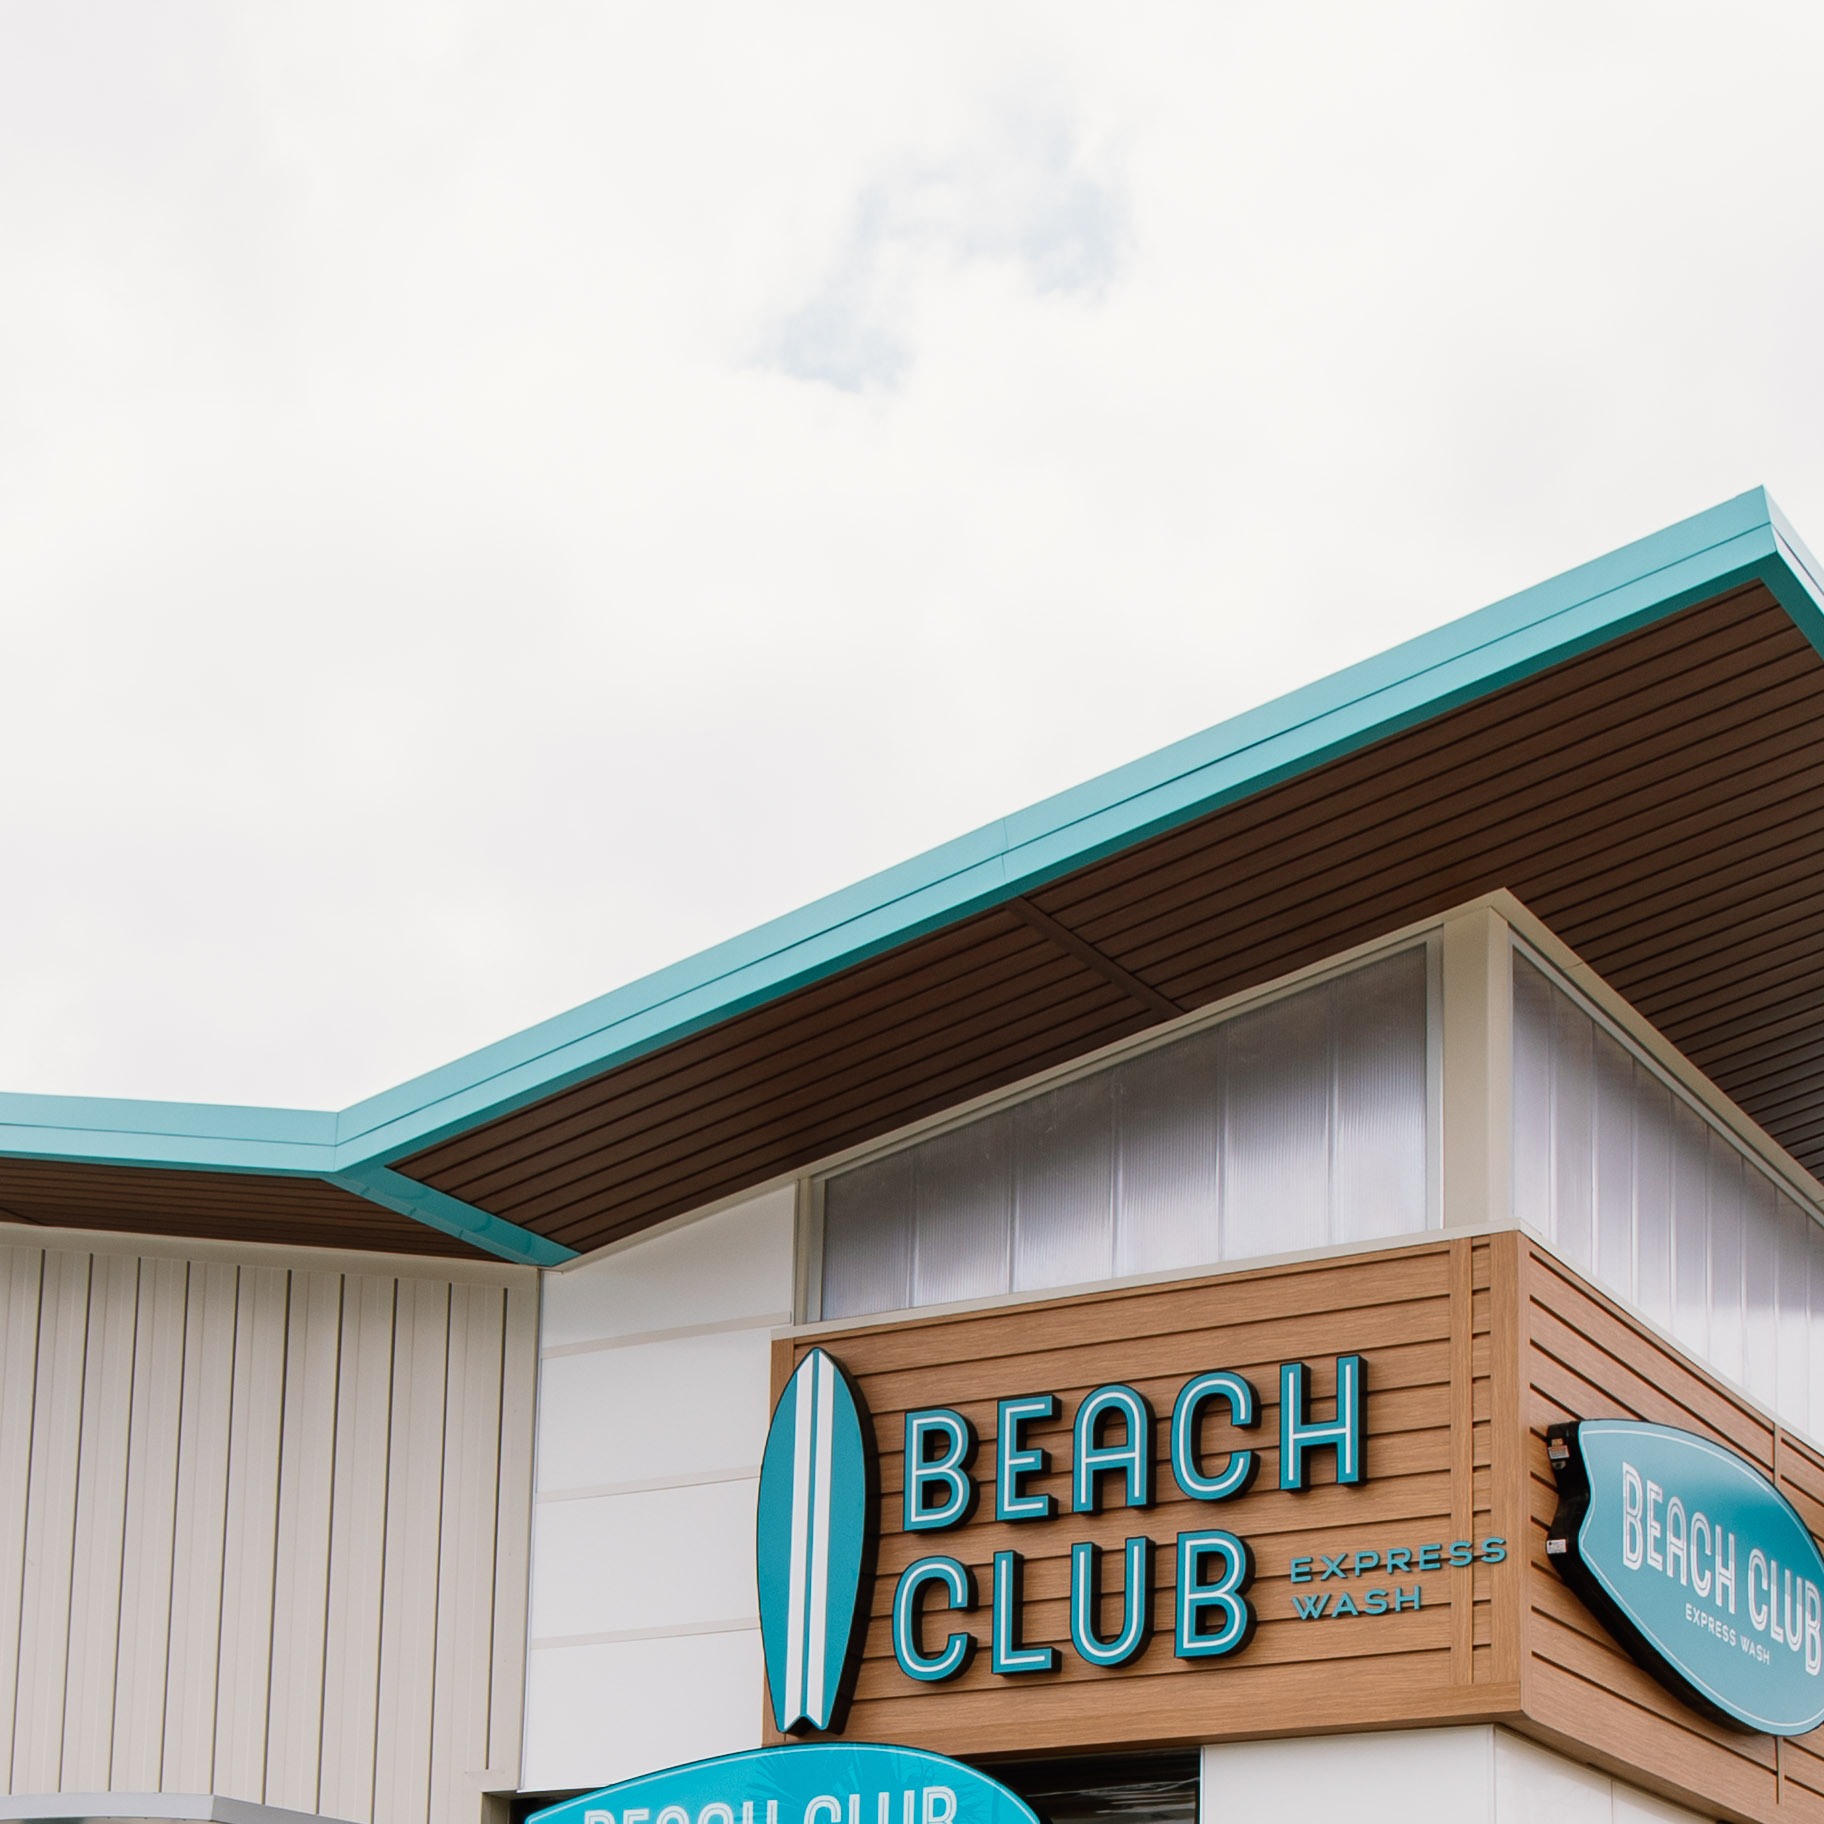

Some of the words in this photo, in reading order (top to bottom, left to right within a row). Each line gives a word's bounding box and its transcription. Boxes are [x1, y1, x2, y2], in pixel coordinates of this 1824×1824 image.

[903, 1355, 1368, 1532] BEACH
[892, 1529, 1257, 1682] CLUB
[1290, 1537, 1507, 1583] EXPRESS
[1293, 1585, 1421, 1620] WASH
[1622, 1461, 1736, 1615] BEACH
[1748, 1548, 1822, 1676] CLUB
[1685, 1602, 1736, 1647] EXPRESS
[1740, 1635, 1771, 1665] WASH
